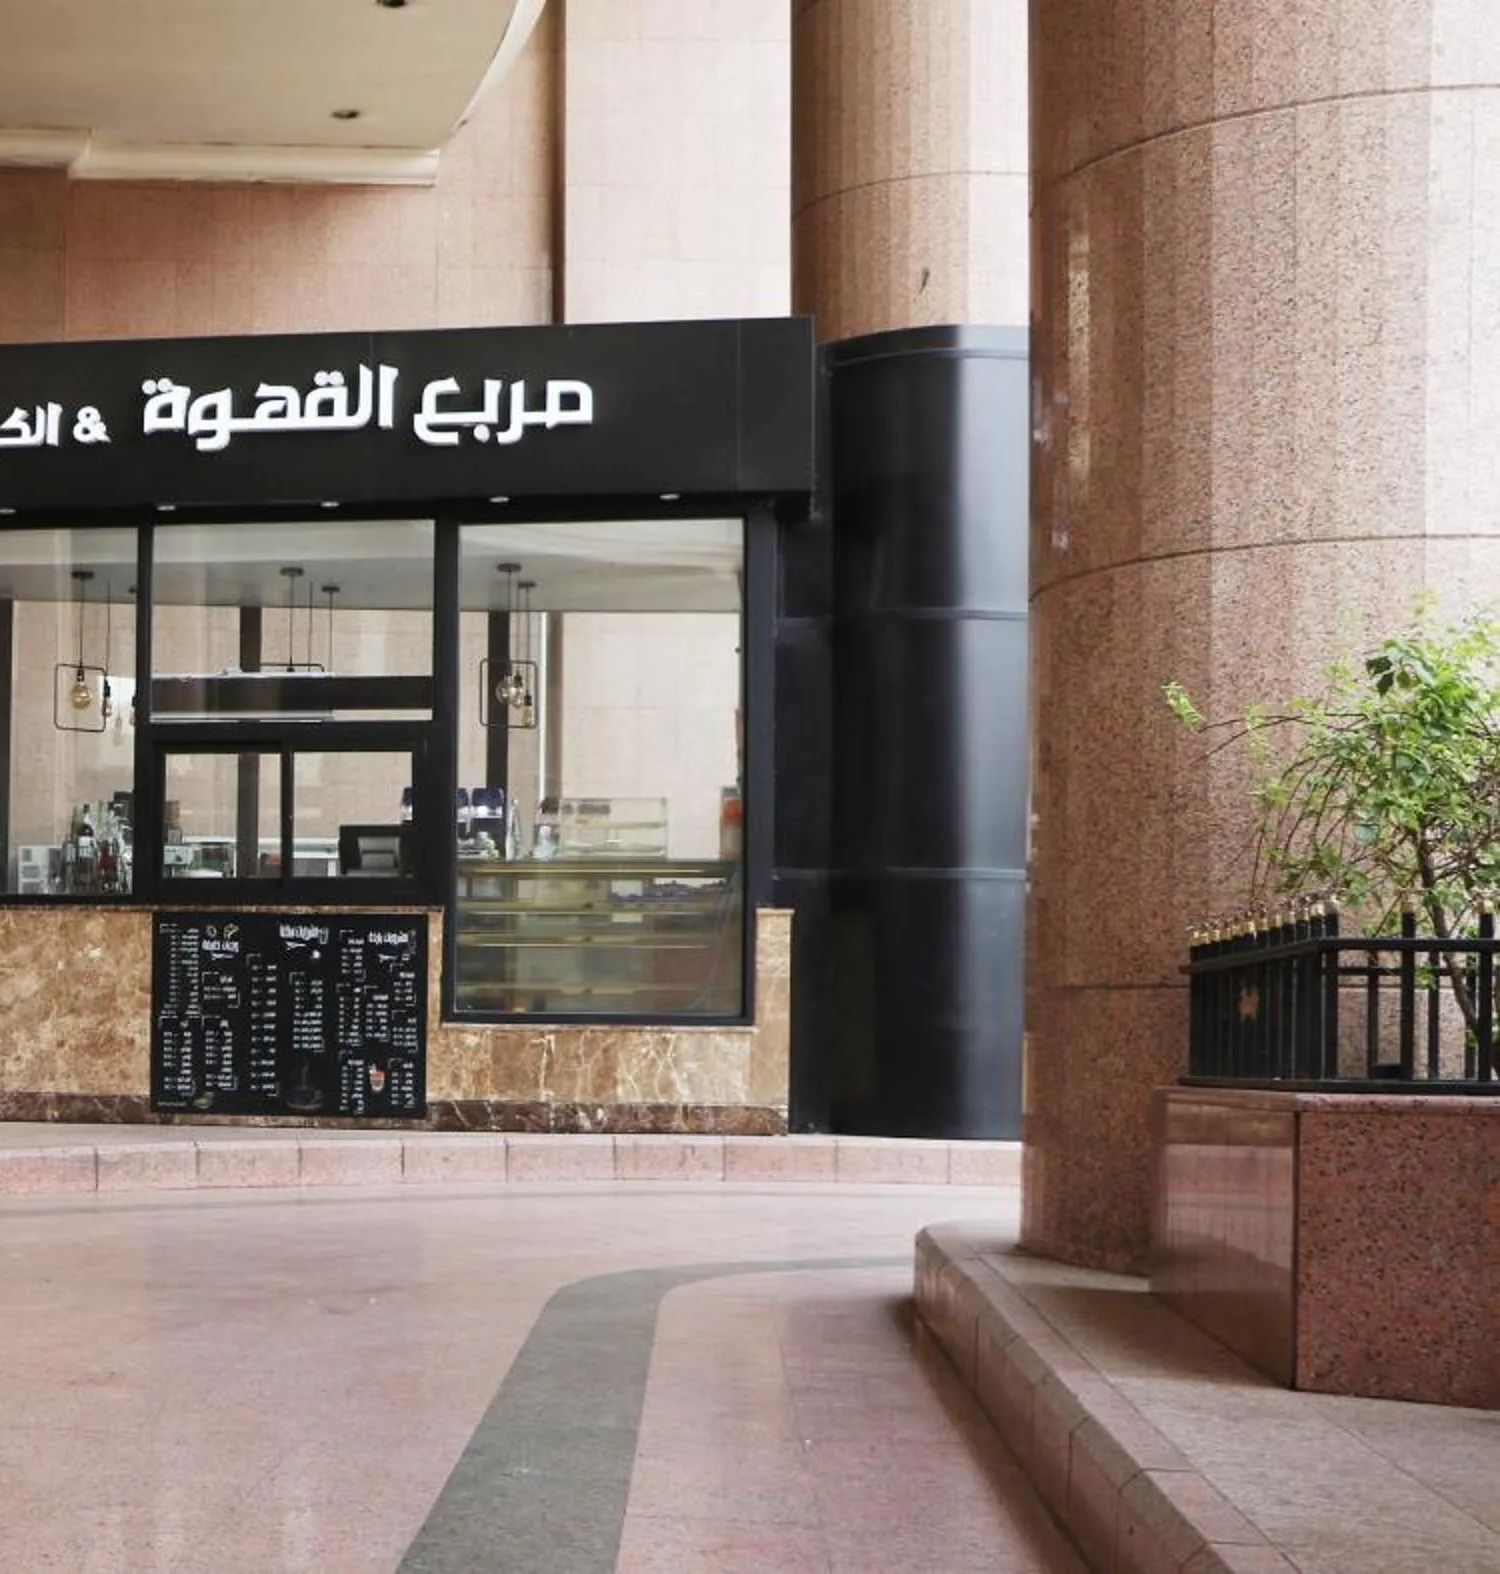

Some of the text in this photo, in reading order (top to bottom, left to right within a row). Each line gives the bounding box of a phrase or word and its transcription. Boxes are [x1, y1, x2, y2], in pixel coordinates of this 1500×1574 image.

[72, 405, 110, 443] &
[141, 363, 399, 451] القهوة
[413, 376, 594, 445] مربع
